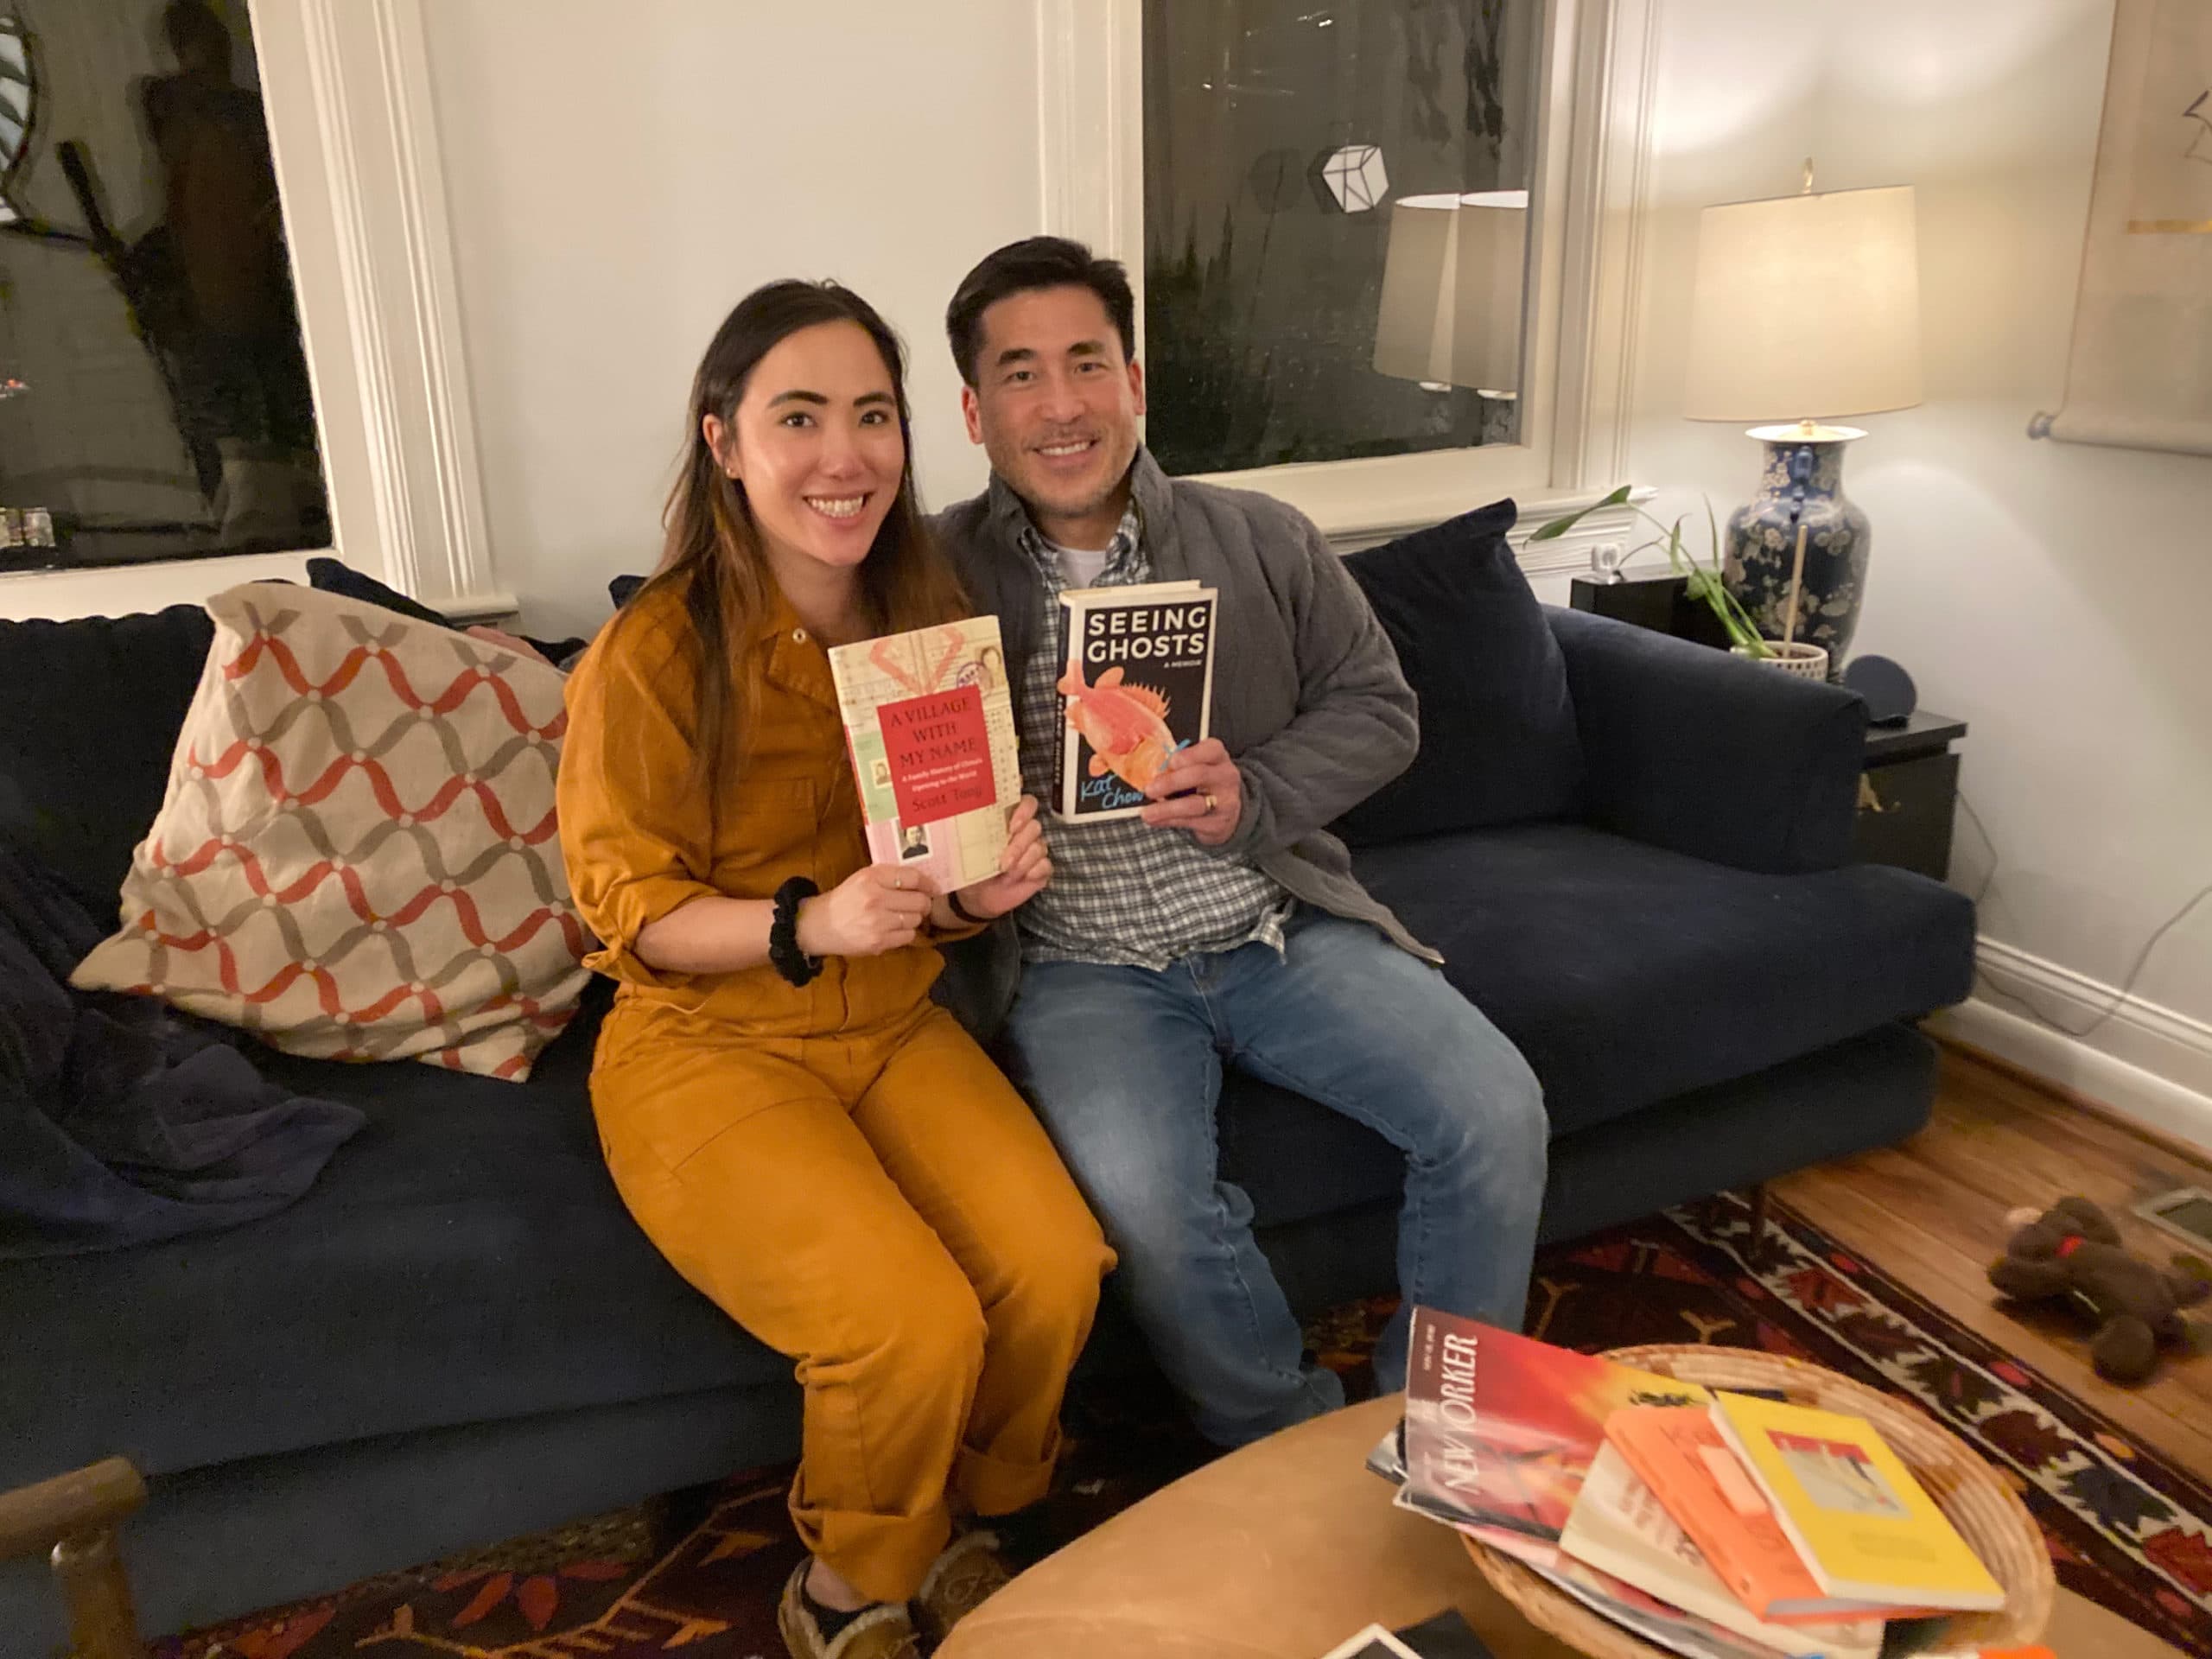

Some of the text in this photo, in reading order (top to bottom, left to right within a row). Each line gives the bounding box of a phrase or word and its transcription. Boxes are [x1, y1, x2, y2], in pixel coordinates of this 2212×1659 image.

[1088, 607, 1207, 637] SEEING
[1087, 632, 1205, 664] GHOSTS
[890, 697, 971, 728] A VILLAGE
[912, 721, 957, 743] WITH
[899, 737, 977, 768] MY NAME
[912, 794, 948, 813] Scott
[1102, 787, 1144, 810] Chow
[1442, 1433, 1481, 1496] NEW
